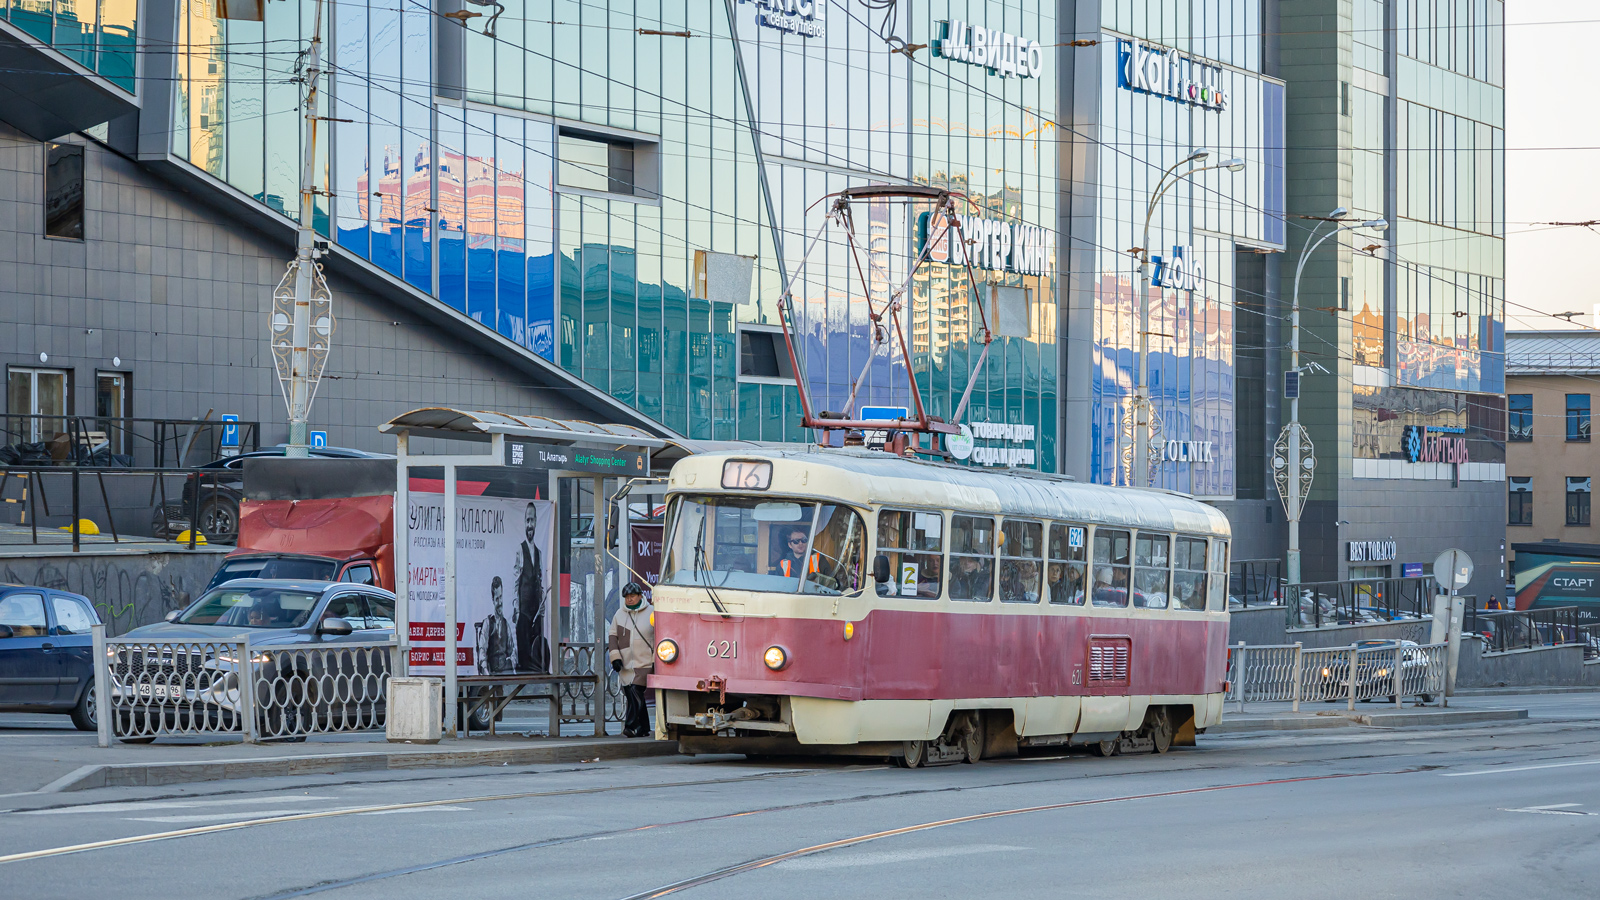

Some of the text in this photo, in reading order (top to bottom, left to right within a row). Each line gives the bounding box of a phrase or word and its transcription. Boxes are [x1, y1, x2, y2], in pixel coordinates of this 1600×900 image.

[770, 14, 826, 38] сеть аутлетов
[1131, 37, 1180, 97] kari
[952, 213, 1011, 271] БУРГЕР
[971, 421, 1035, 444] ТОВАРЫ ДЛЯ
[539, 451, 568, 464] ТЦ Алатырь
[574, 454, 627, 468] Alatyr Shopping Center
[973, 447, 999, 467] САДА
[1008, 448, 1035, 468] ДАЧИ
[1150, 439, 1213, 463] TOLNIK
[736, 463, 761, 488] 16
[461, 507, 505, 535] КЛАССИК
[1070, 528, 1082, 546] 621
[637, 541, 651, 557] DK
[1350, 541, 1397, 562] BEST TOBACCO
[412, 566, 438, 586] МАРТА
[1553, 577, 1595, 588] СТАРТ
[408, 627, 424, 637] АВЕЛ
[411, 652, 430, 662] БОРИС
[706, 640, 738, 659] 621
